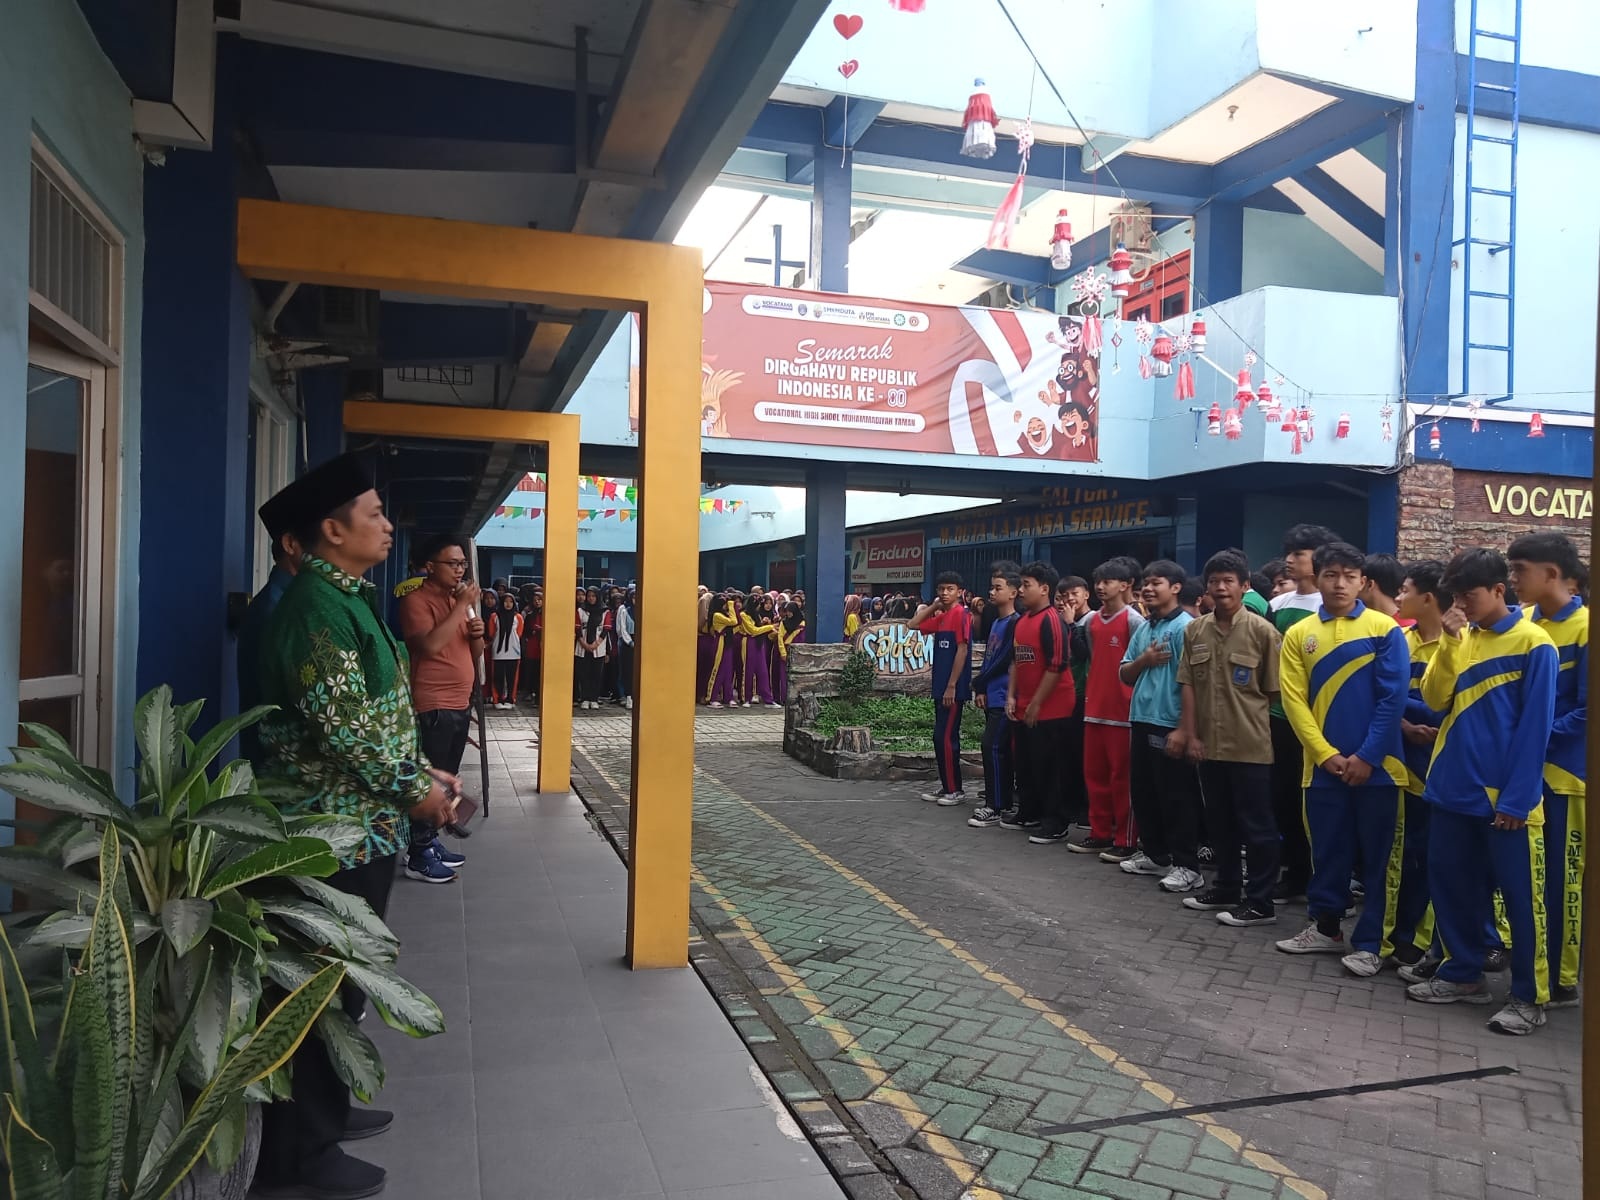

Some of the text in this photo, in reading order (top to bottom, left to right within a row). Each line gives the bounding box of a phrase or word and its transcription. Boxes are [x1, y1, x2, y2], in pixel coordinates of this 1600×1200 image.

[793, 336, 894, 364] Semarak
[764, 358, 918, 387] DIRGAHAYU REPUBLIK
[777, 379, 853, 401] INDONESIA
[857, 387, 875, 402] KE
[764, 407, 802, 418] VOCATIONAL
[804, 410, 819, 420] HIGH
[1070, 499, 1150, 532] SERVICE
[868, 544, 922, 561] Enduro
[1566, 891, 1580, 945] DUTA
